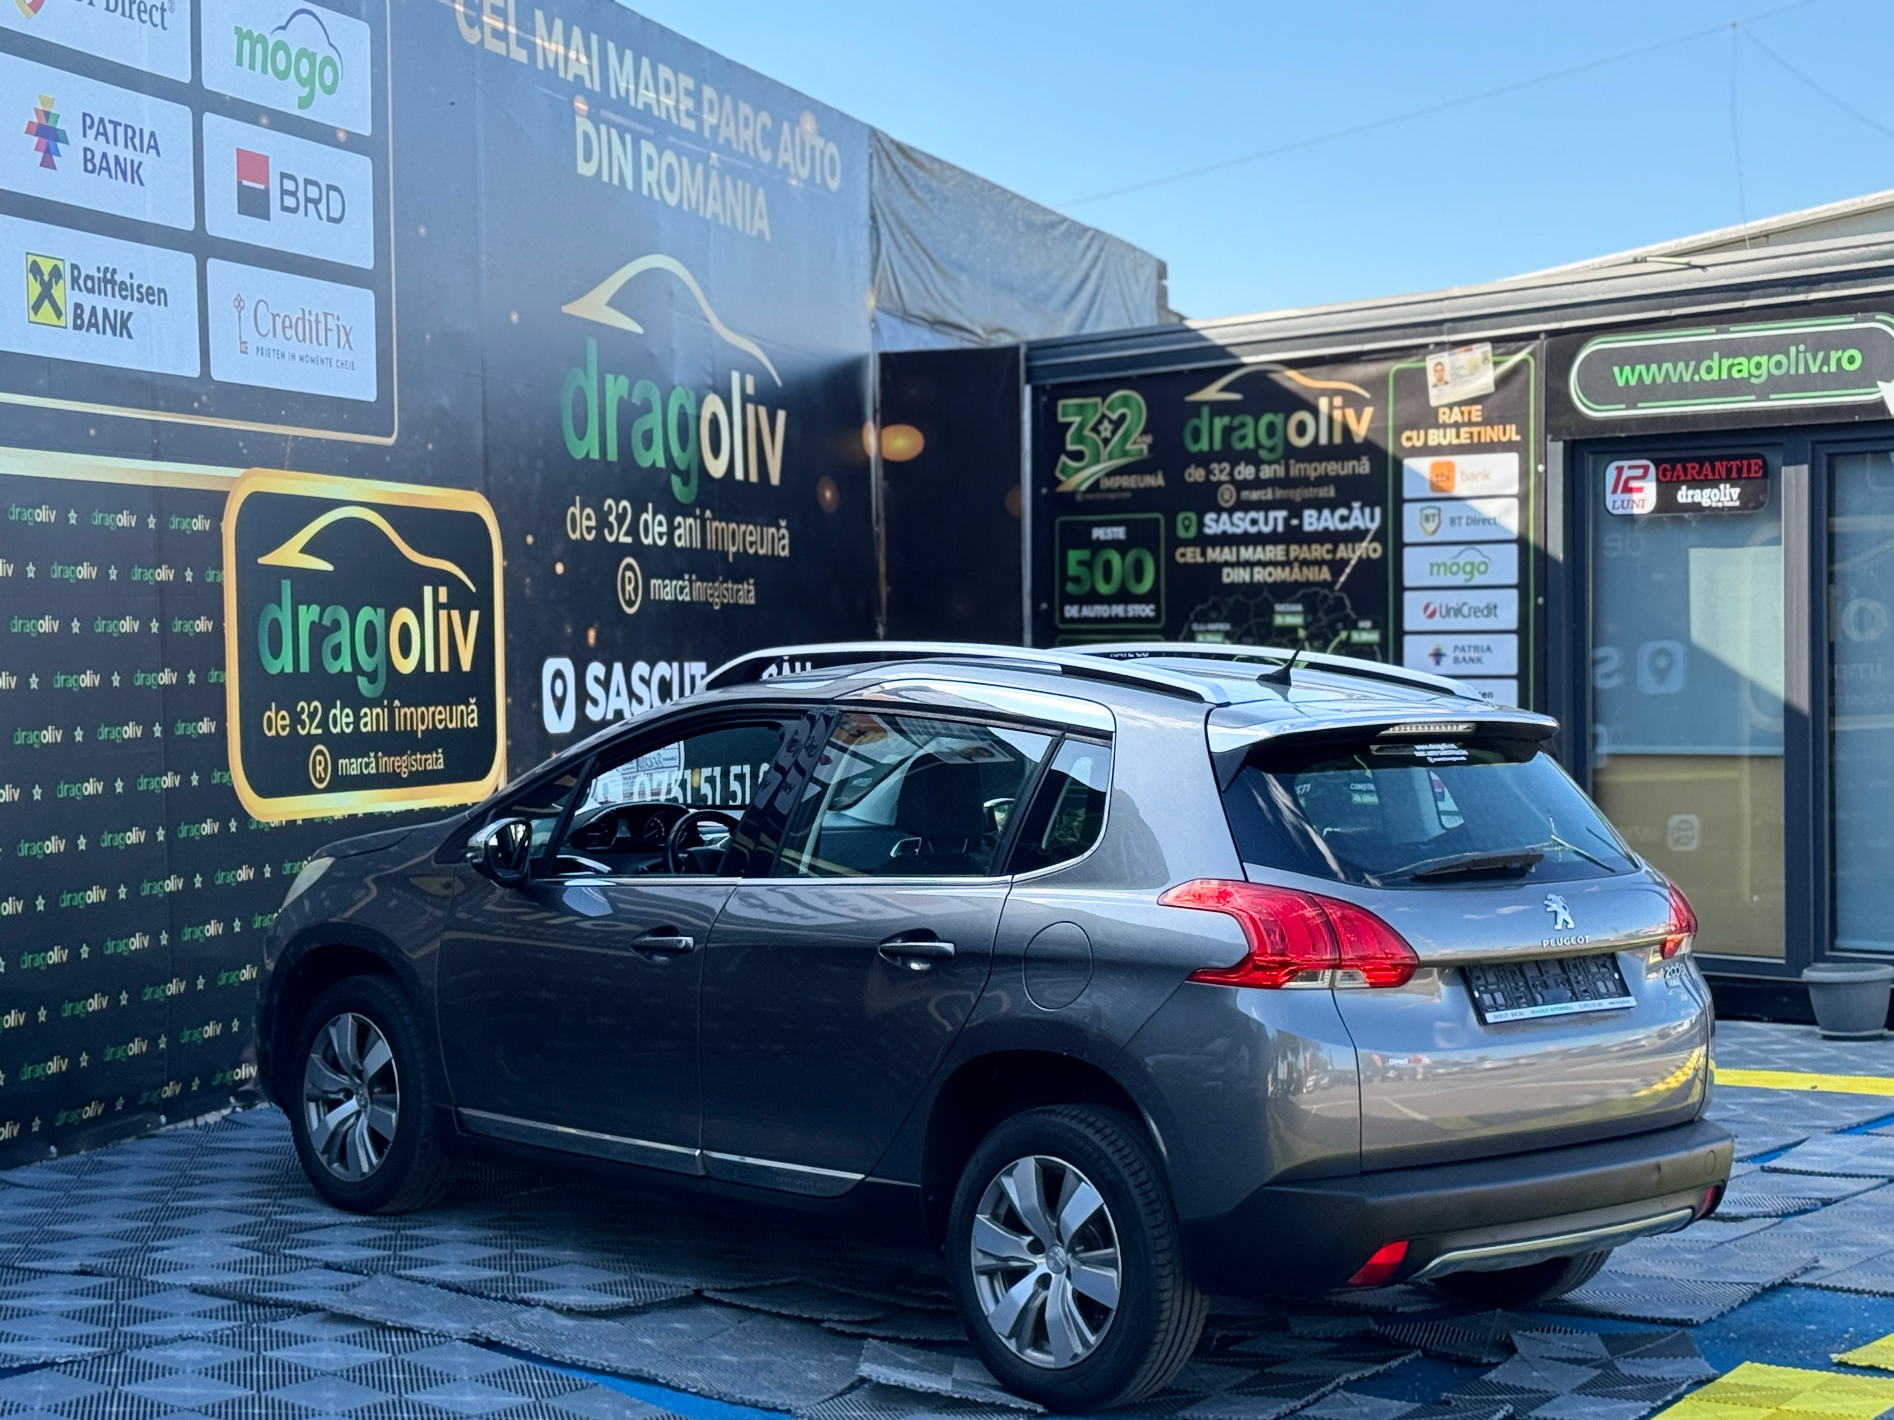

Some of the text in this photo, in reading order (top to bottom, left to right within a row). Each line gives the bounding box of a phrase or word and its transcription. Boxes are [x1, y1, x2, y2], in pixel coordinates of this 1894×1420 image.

[234, 25, 340, 110] mogo
[454, 0, 842, 193] CEL MAI MARE PARC AUTO
[81, 111, 161, 158] PATRIA
[82, 151, 145, 187] BANK
[575, 114, 771, 242] DIN ROMÂNIA
[279, 171, 346, 225] BRD
[70, 262, 168, 308] Raiffeisen
[72, 304, 134, 340] BANK
[253, 299, 354, 351] CreditFix
[1612, 344, 1863, 387] www.dragoliv.ro
[561, 337, 787, 504] dragoliv
[1183, 396, 1374, 461] dragoliv
[1438, 405, 1483, 424] RATE
[1055, 389, 1148, 482] 32
[1401, 424, 1521, 448] CU BULETINUL
[1184, 456, 1370, 483] de 32 de ani împreună
[1460, 469, 1491, 482] bank
[1611, 458, 1763, 495] 12 GARANTIE
[1240, 486, 1274, 501] marcă
[1611, 499, 1646, 511] LUNI
[1677, 483, 1741, 507] dragoliv
[8, 503, 211, 534] dragoliv dragoliv dragoliv
[566, 496, 790, 563] de 32 de ani împreună
[1091, 526, 1127, 540] PESTE
[1203, 510, 1288, 535] SASCUT
[1302, 501, 1381, 533] BACĂU
[1175, 541, 1383, 563] CEL MAI MARE PARC AUTO
[50, 561, 97, 583] dragoliv
[131, 564, 175, 585] dragoliv
[1065, 547, 1155, 595] 500
[1221, 562, 1332, 584] DIN ROMÂNIA
[1429, 561, 1489, 583] mogo
[650, 573, 691, 602] marcă
[692, 574, 756, 610] înregistrată
[10, 615, 213, 637] dragoliv dragoliv dragoliv
[1064, 603, 1156, 618] DE AUTO PE STOC
[1439, 602, 1498, 619] UniCredit
[258, 579, 480, 699] dragoliv
[53, 668, 177, 692] dragoliv dragoliv
[14, 717, 216, 748] dragoliv dragoliv dragoliv
[263, 697, 478, 739] de 32 de ani împreună
[338, 750, 377, 776] marcă
[377, 749, 445, 779] înregistrată
[57, 778, 104, 800] dragoliv
[137, 771, 180, 793] dragoliv
[700, 765, 721, 805] 51
[729, 764, 750, 805] 51
[17, 835, 66, 858] dragoliv
[100, 827, 146, 850] dragoliv
[178, 818, 219, 840] dragoliv
[59, 885, 107, 909] dragoliv
[140, 874, 184, 897] dragoliv
[214, 864, 255, 886] dragoliv
[20, 945, 68, 970] dragoliv
[103, 932, 150, 956] dragoliv
[181, 919, 224, 942] dragoliv
[1541, 934, 1590, 949] PEUGEOT
[61, 993, 109, 1017] dragoliv
[141, 978, 186, 1002] dragoliv
[217, 964, 258, 986] dragoliv
[20, 1020, 222, 1081] dragoliv dragoliv dragoliv
